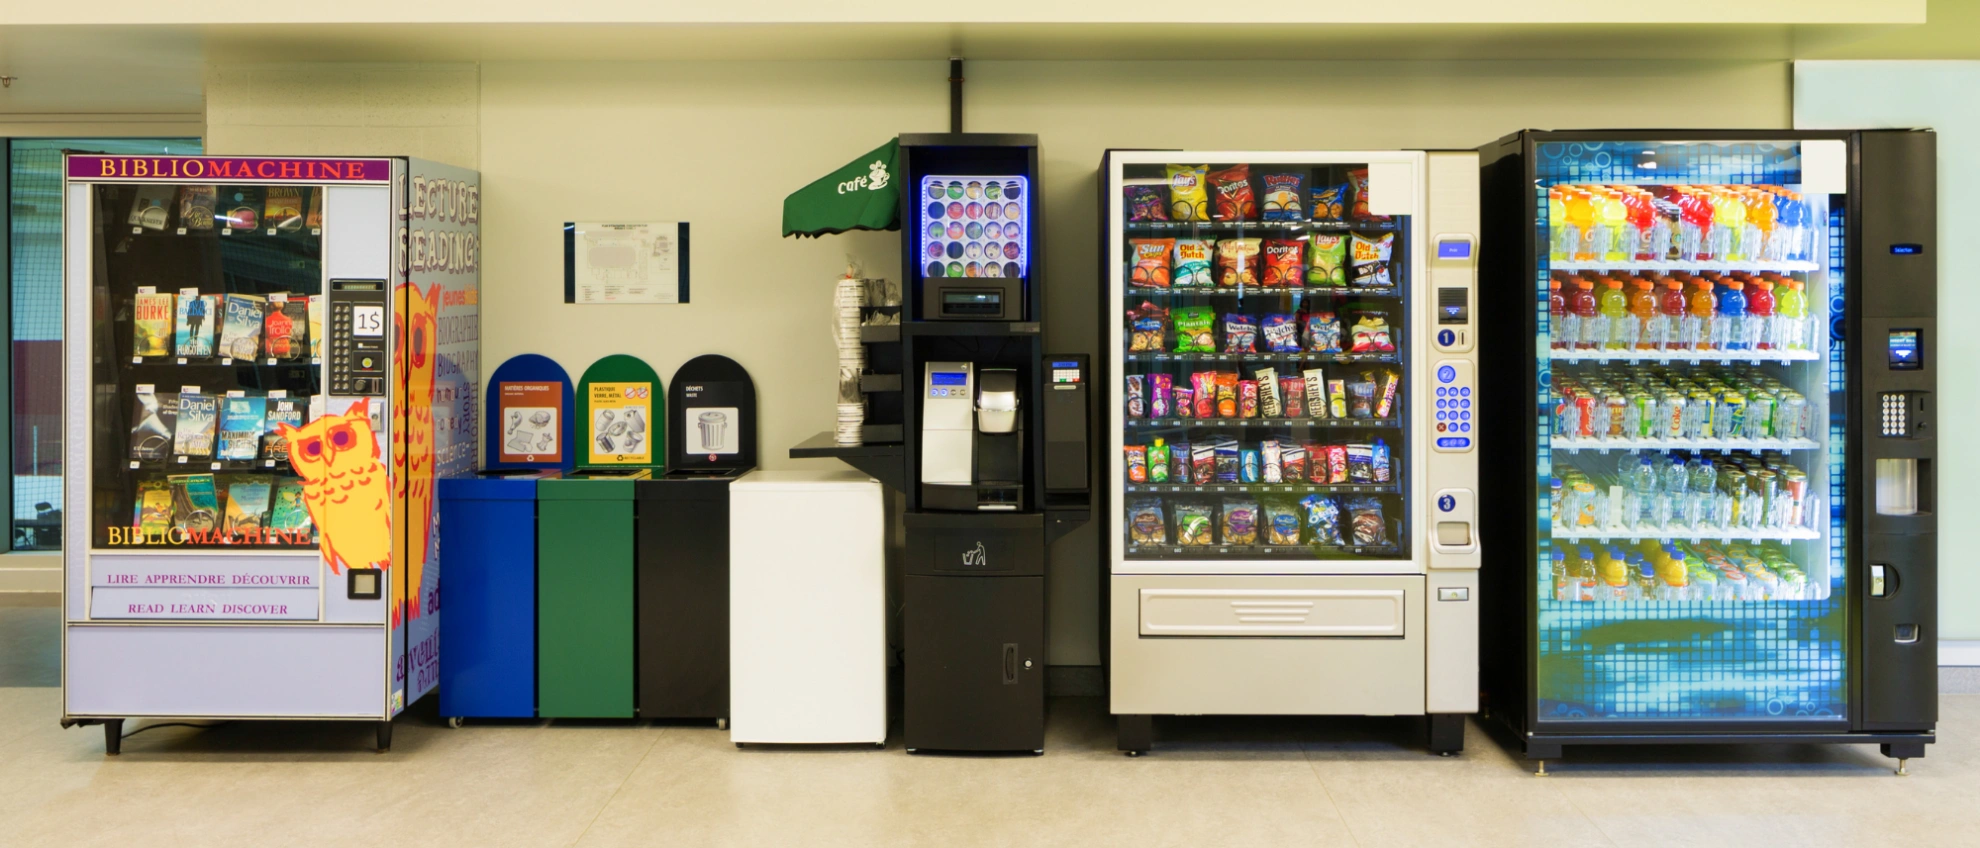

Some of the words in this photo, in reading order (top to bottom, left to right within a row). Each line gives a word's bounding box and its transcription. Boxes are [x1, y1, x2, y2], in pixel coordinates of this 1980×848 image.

[100, 158, 365, 179] BIBLIOMACHINE
[837, 175, 868, 194] café
[398, 173, 478, 226] LECTURE
[1140, 244, 1165, 255] Sun
[1180, 243, 1195, 251] Old
[1266, 246, 1299, 255] Doritos
[1356, 241, 1371, 251] Old
[1355, 251, 1379, 260] Dutch
[136, 305, 169, 320] BURKE
[228, 302, 263, 318] Daniel
[235, 315, 260, 328] Silva
[1443, 332, 1449, 344] 1
[180, 399, 215, 411] Daniel
[277, 401, 293, 411] JOHN
[188, 410, 214, 422] Silva
[268, 411, 301, 420] SANDFORD
[1443, 497, 1451, 510] 3
[108, 526, 311, 545] BIBLIOMACHINE
[107, 574, 138, 584] LIRE
[145, 574, 225, 584] APPRENDRE
[232, 572, 310, 585] DÉCOUVRIR
[128, 604, 164, 613] READ
[170, 604, 216, 614] LEARN
[222, 604, 288, 614] DISCOVER
